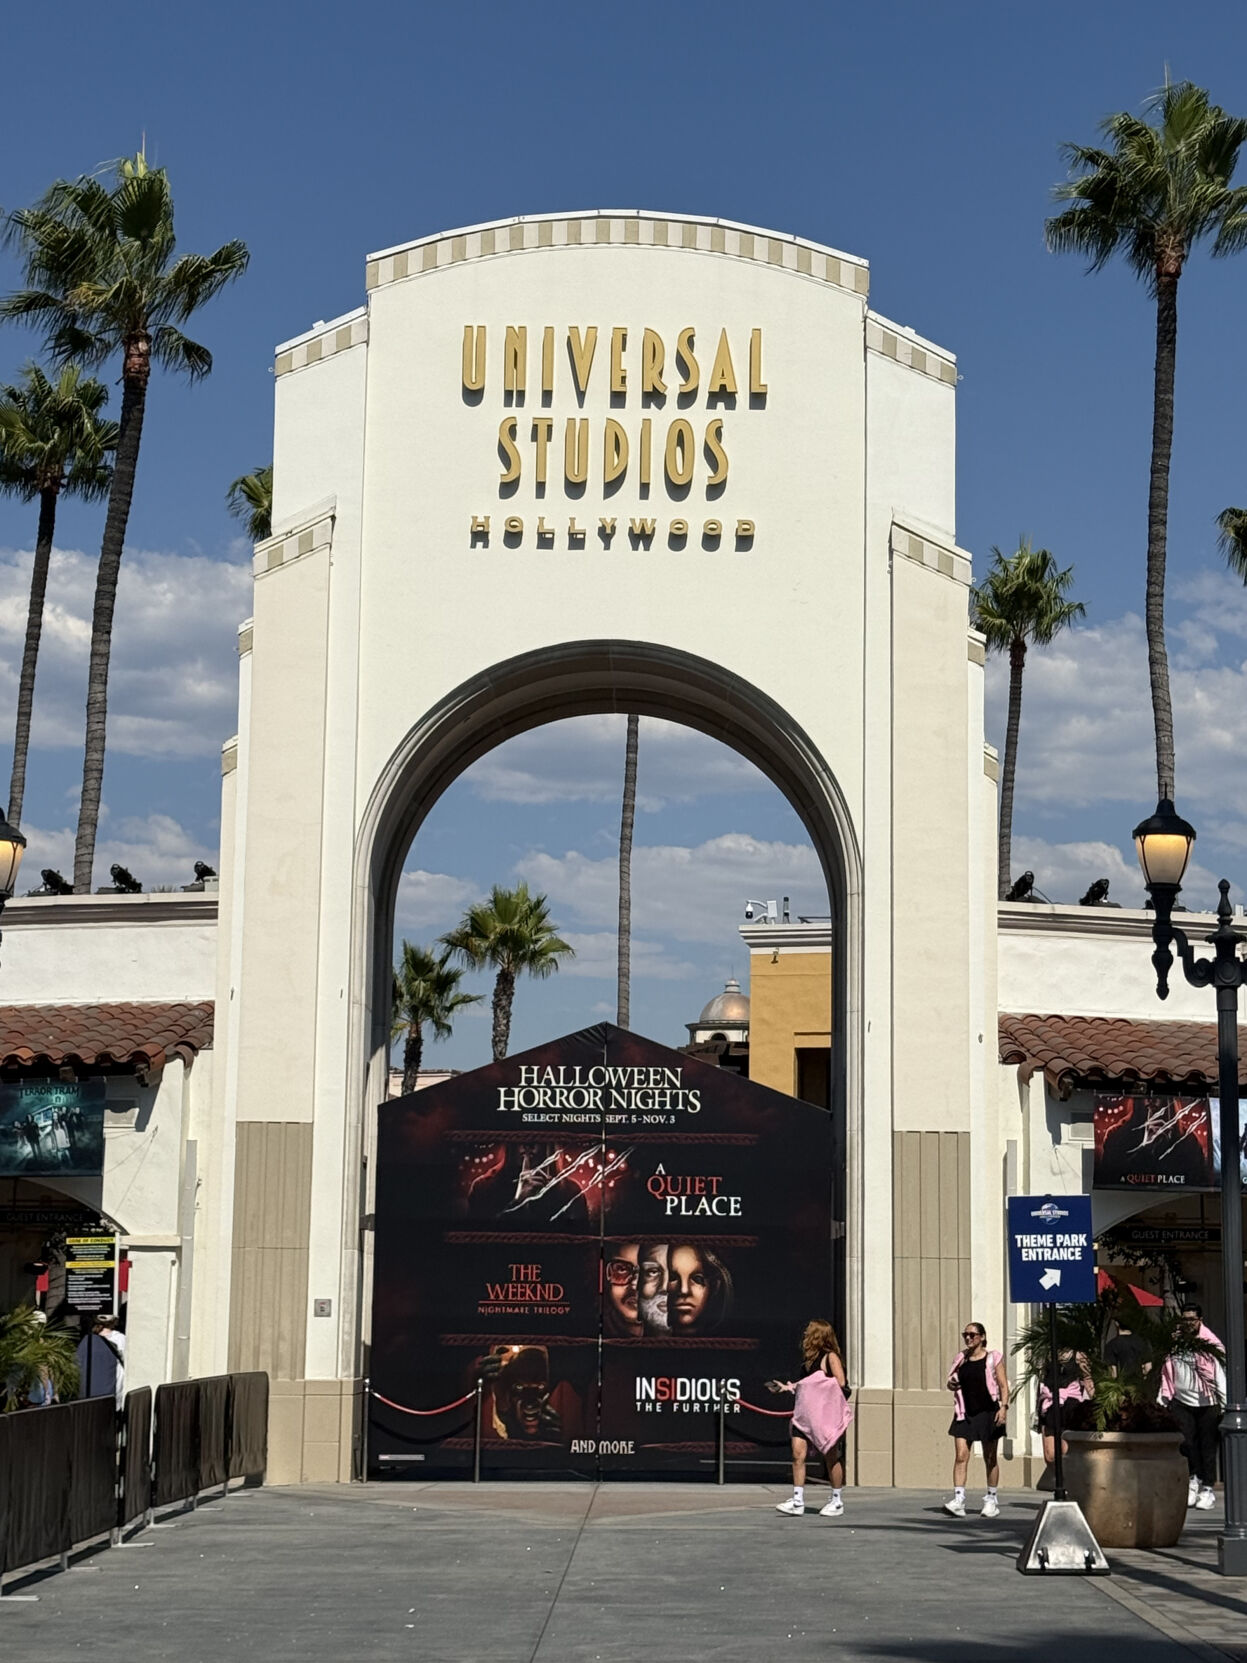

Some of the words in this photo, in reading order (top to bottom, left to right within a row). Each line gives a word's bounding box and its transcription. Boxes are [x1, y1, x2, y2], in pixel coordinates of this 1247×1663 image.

[462, 325, 768, 394] UNIVERSAL
[498, 416, 729, 485] STUDIOS
[470, 515, 756, 537] HOLLYWOOD
[518, 1065, 683, 1088] HALLOWEEN
[19, 1087, 53, 1098] TERROR
[54, 1086, 79, 1097] TRAM
[496, 1087, 604, 1111] HORROR
[609, 1089, 701, 1113] NIGHTS
[522, 1113, 561, 1123] SELECT
[561, 1113, 601, 1123] NIGHTS
[605, 1114, 630, 1124] SEPT.
[669, 1115, 676, 1124] 3
[655, 1163, 666, 1175] A
[647, 1175, 723, 1199] QUIET
[1127, 1174, 1156, 1184] QUIET
[1157, 1175, 1186, 1184] PLACE
[665, 1195, 742, 1216] PLACE
[1014, 1234, 1054, 1247] THEME
[1056, 1234, 1088, 1247] PARK
[1131, 1230, 1159, 1239] GUEST
[1162, 1230, 1209, 1239] ENTRANCE
[1021, 1247, 1082, 1261] ENTRANCE
[508, 1263, 542, 1281] THE
[486, 1283, 564, 1301] WEEKND
[477, 1306, 529, 1315] NIGHTMARE
[534, 1306, 571, 1315] TRILOGY
[635, 1377, 741, 1401] INSIDIOUS
[635, 1402, 662, 1412] THE
[570, 1440, 596, 1453] AND
[599, 1440, 635, 1454] MORE
